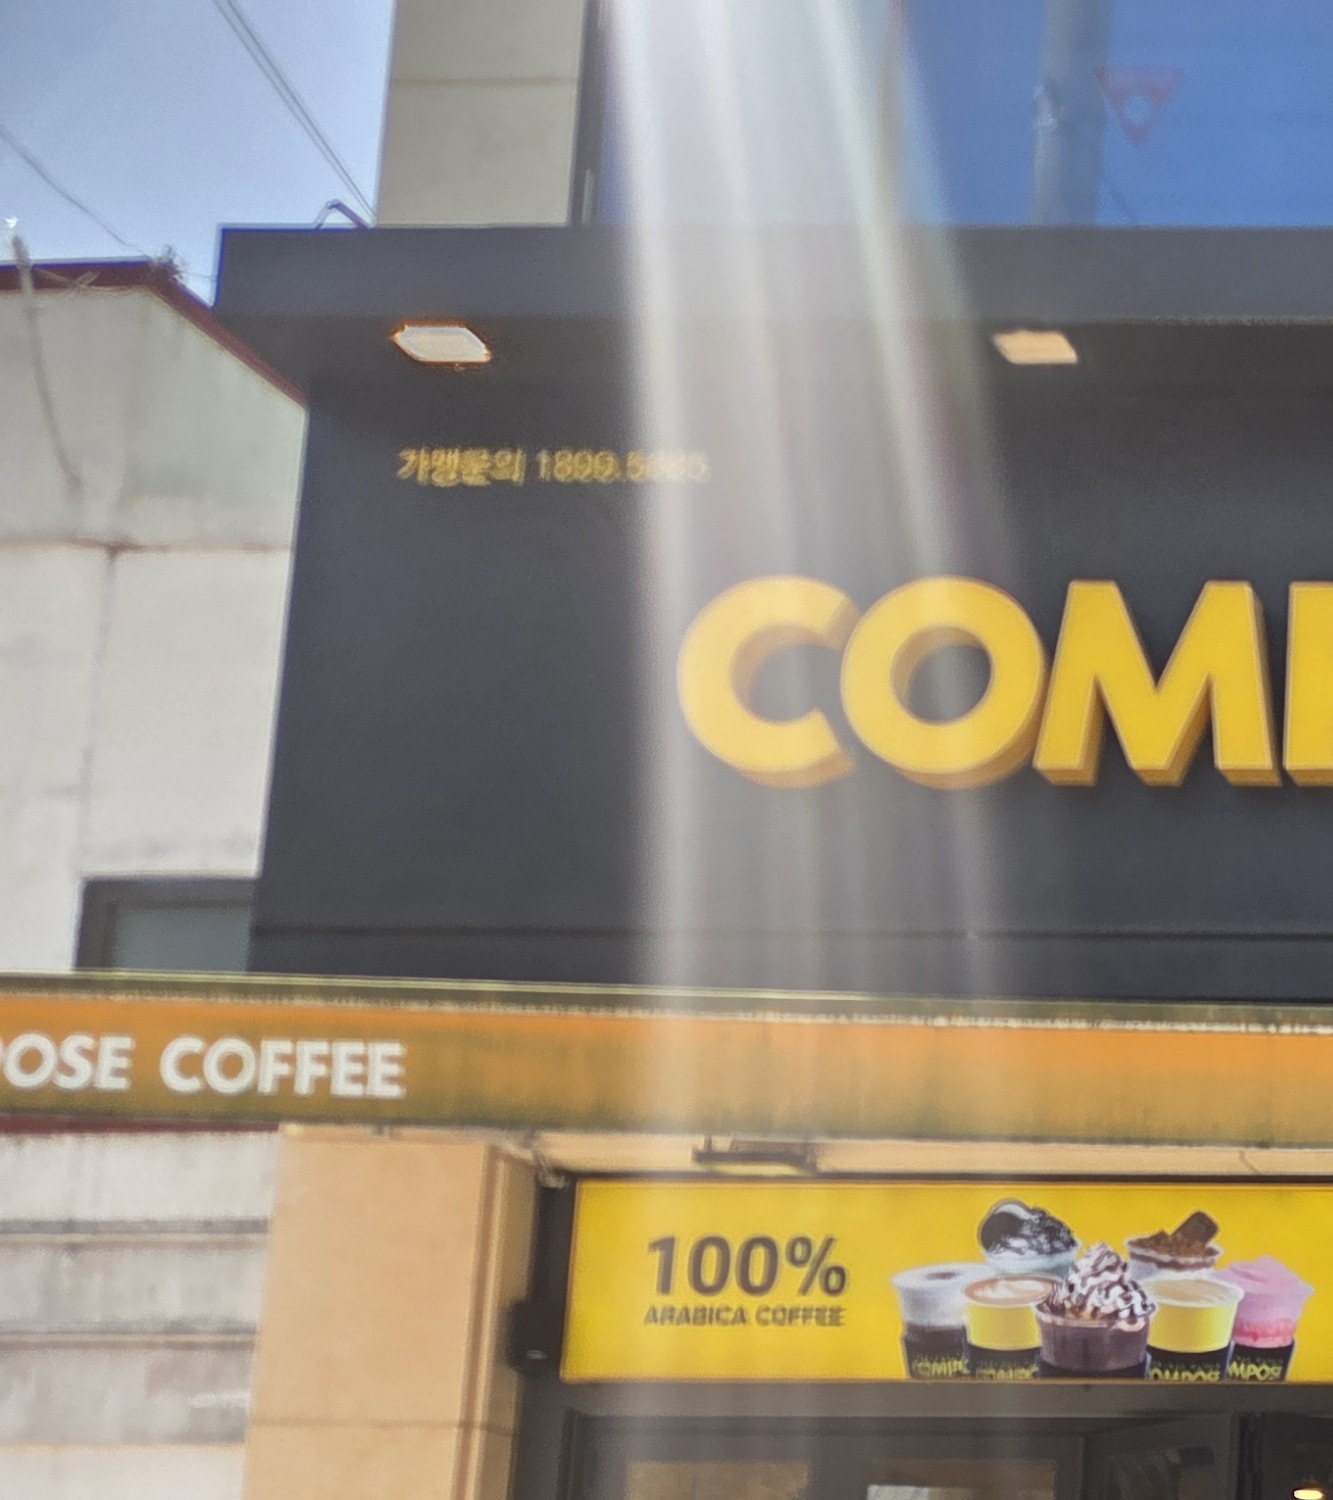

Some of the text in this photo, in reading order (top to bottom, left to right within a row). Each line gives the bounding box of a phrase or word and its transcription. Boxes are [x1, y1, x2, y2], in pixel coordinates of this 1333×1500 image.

[0, 1033, 407, 1098] OSE COFFEE
[647, 1234, 848, 1297] 100%
[643, 1304, 846, 1327] ARABICA COFFEE
